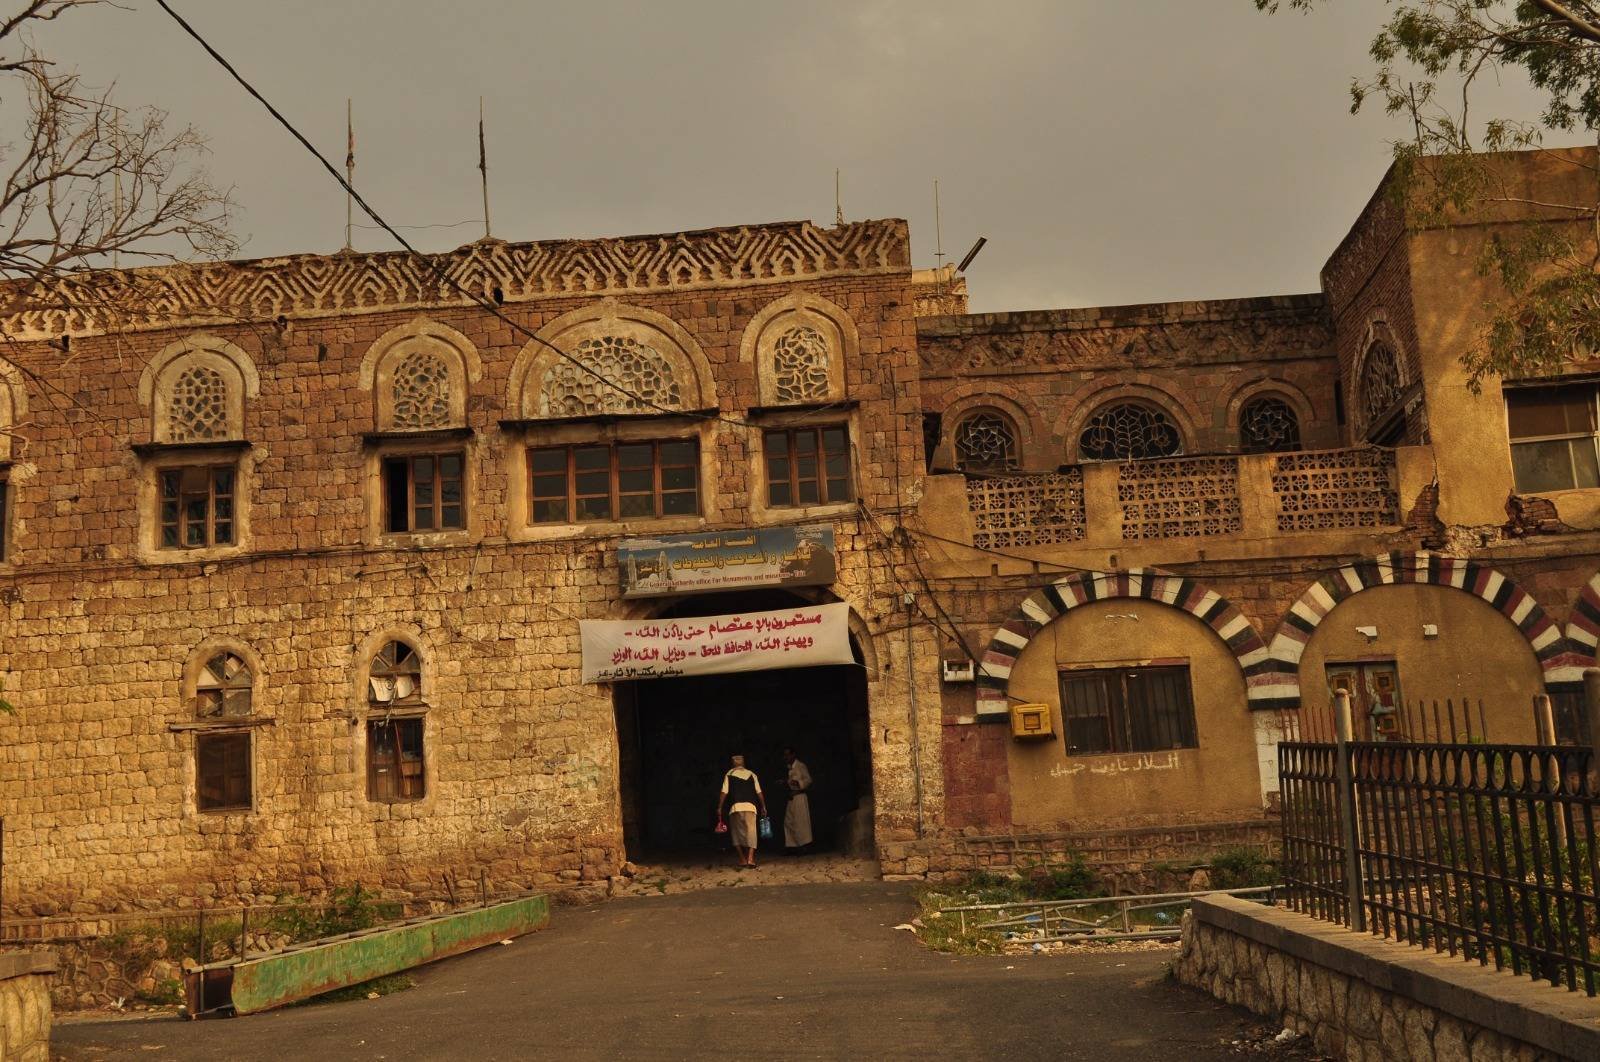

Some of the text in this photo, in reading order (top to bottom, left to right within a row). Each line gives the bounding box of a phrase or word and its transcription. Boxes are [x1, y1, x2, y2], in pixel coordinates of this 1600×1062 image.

[771, 612, 822, 630] مستمرون
[635, 625, 660, 638] الله
[683, 625, 705, 640] حتى
[755, 636, 780, 651] الله
[783, 635, 814, 652] ويهدي
[633, 646, 659, 661] الله
